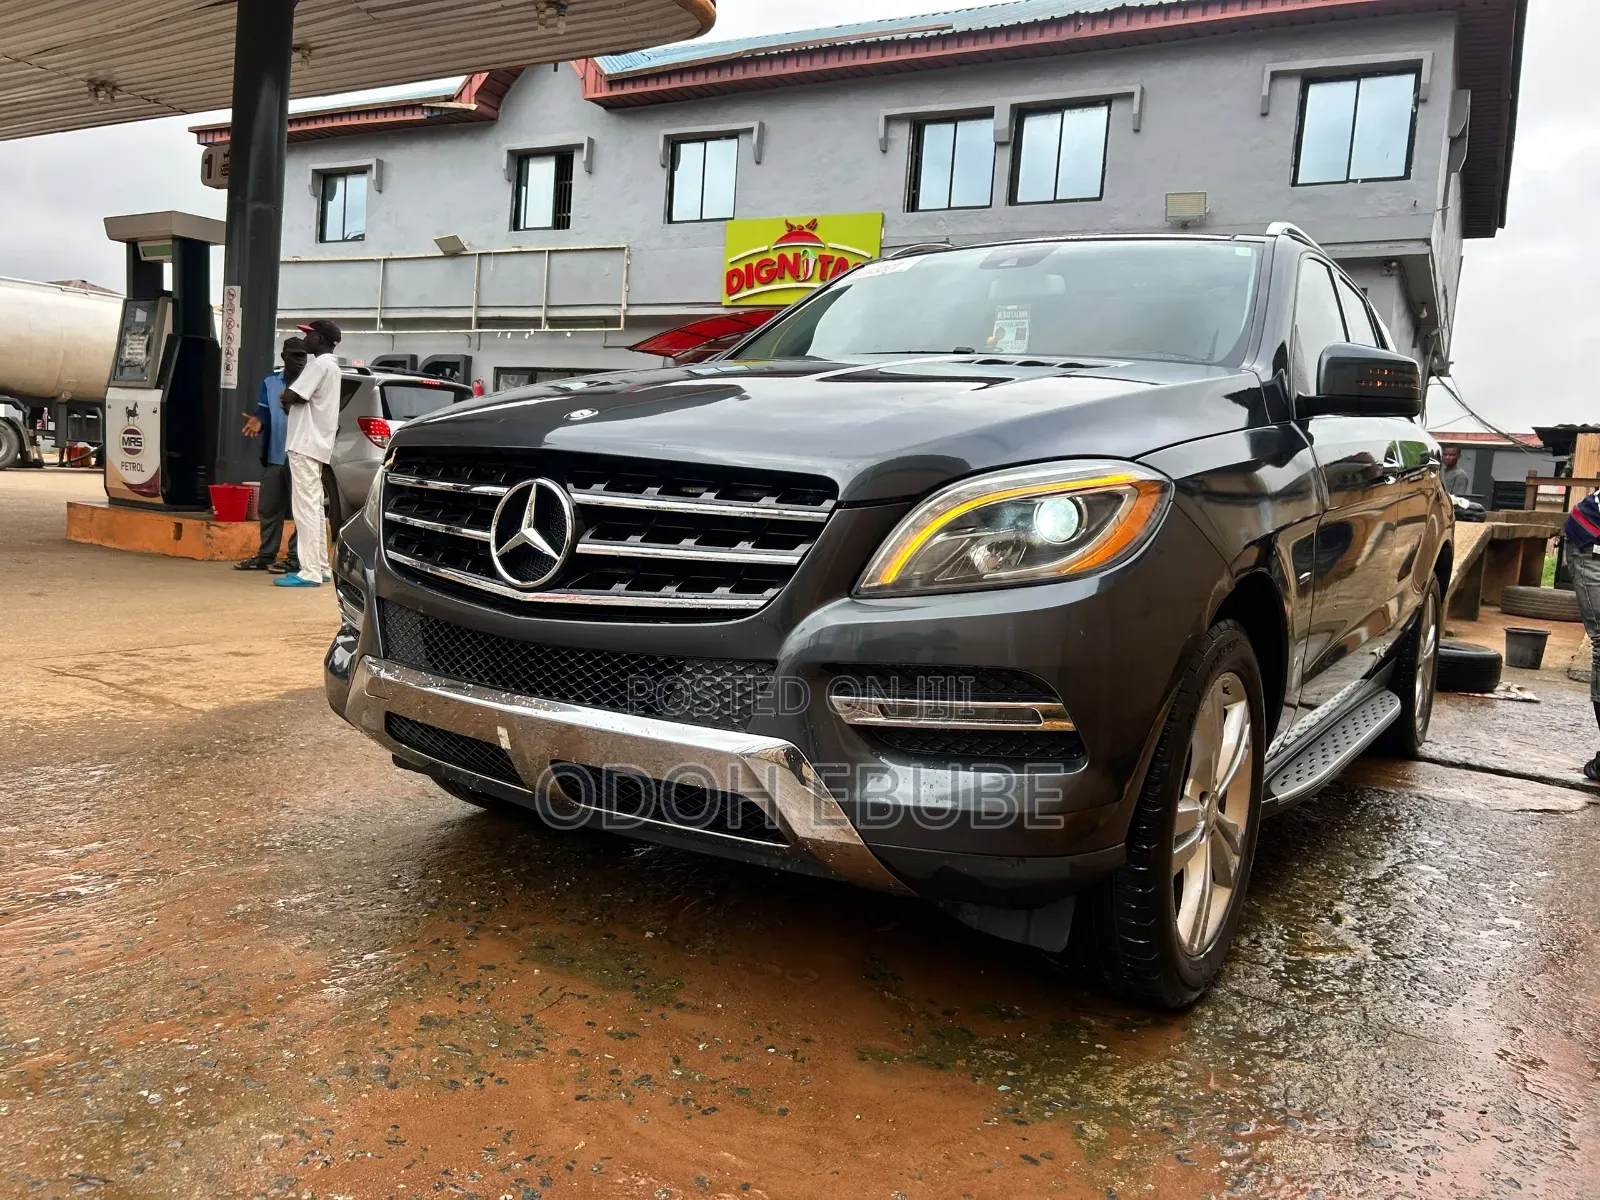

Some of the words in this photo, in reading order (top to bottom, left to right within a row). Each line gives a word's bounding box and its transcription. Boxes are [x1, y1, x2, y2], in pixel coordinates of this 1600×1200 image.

[204, 153, 213, 179] 1
[726, 248, 861, 295] DIGNITA
[121, 436, 143, 447] MRS
[120, 461, 145, 473] PETROL
